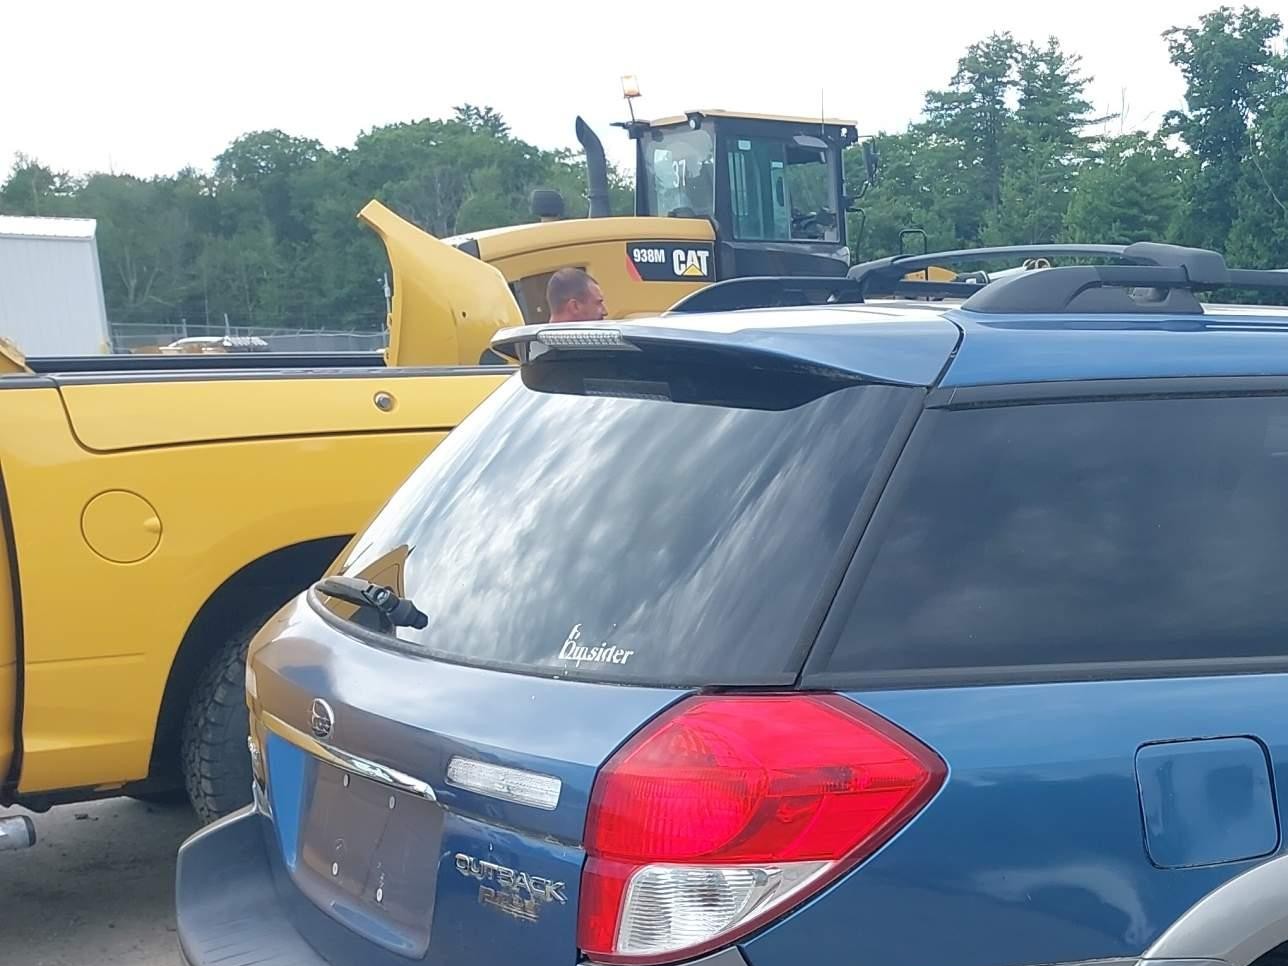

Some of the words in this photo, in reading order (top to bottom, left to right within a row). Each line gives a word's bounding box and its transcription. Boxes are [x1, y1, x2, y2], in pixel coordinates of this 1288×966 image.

[672, 159, 687, 188] 37
[633, 248, 666, 263] 938M
[672, 249, 709, 276] CAT
[455, 853, 568, 904] OUTBACK
